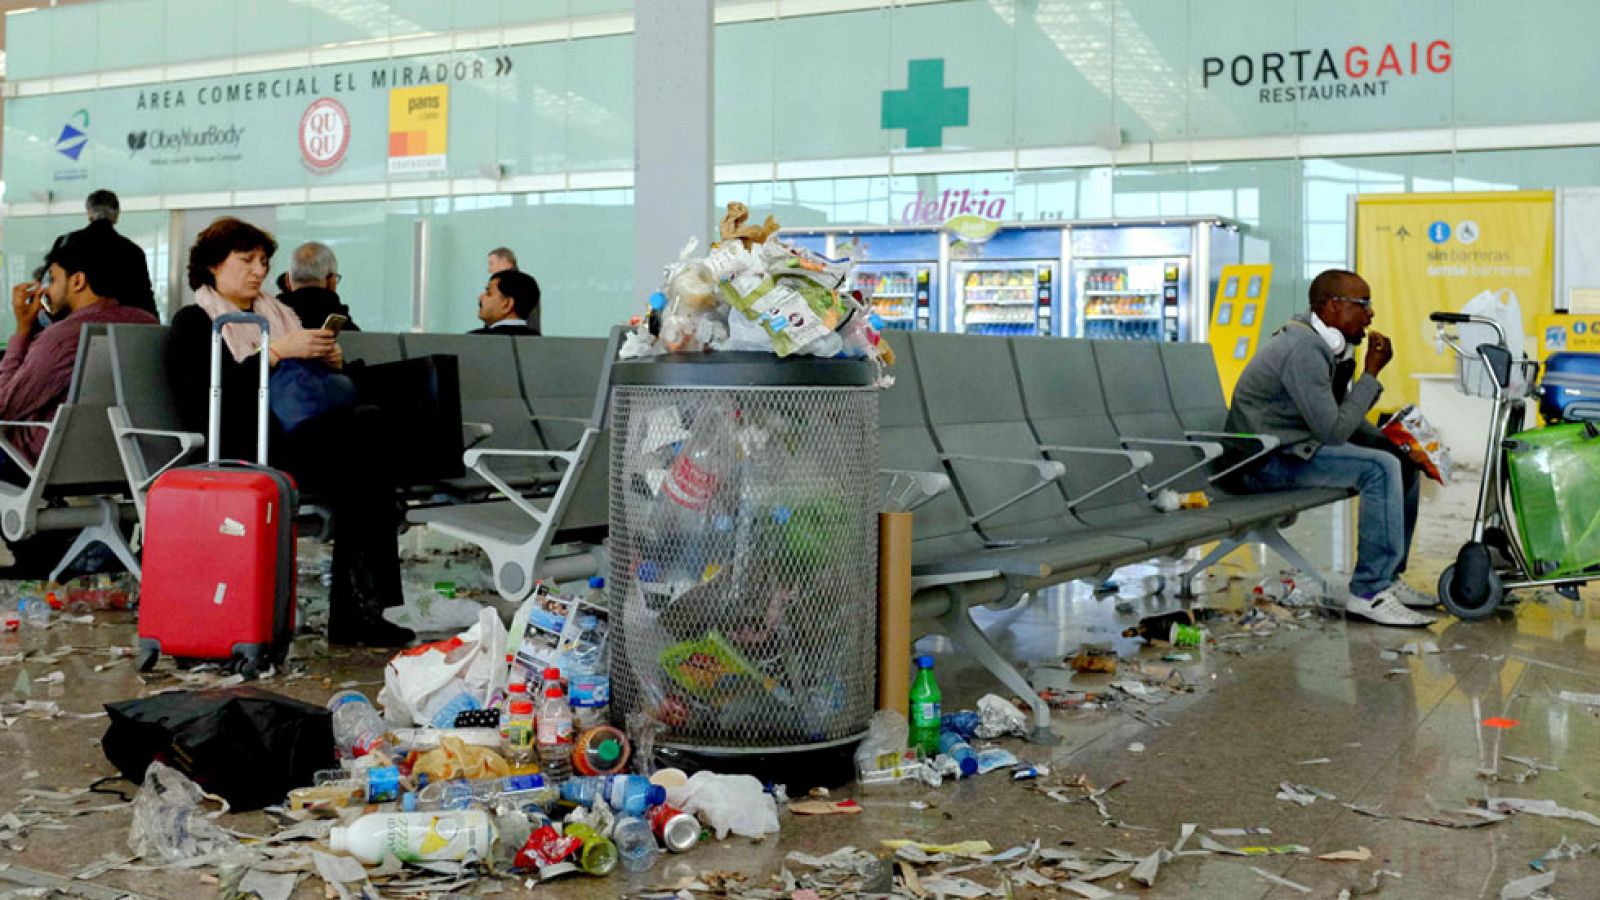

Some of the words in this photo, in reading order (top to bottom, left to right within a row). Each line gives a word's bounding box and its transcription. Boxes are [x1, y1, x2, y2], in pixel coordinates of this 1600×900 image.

[198, 77, 319, 105] COMERCIAL
[334, 73, 356, 92] EL
[372, 60, 484, 88] MIRADOR
[1259, 80, 1389, 103] RESTAURANT
[408, 96, 440, 115] pans
[310, 112, 336, 132] QU
[310, 133, 336, 156] QU
[902, 189, 1006, 224] delikia
